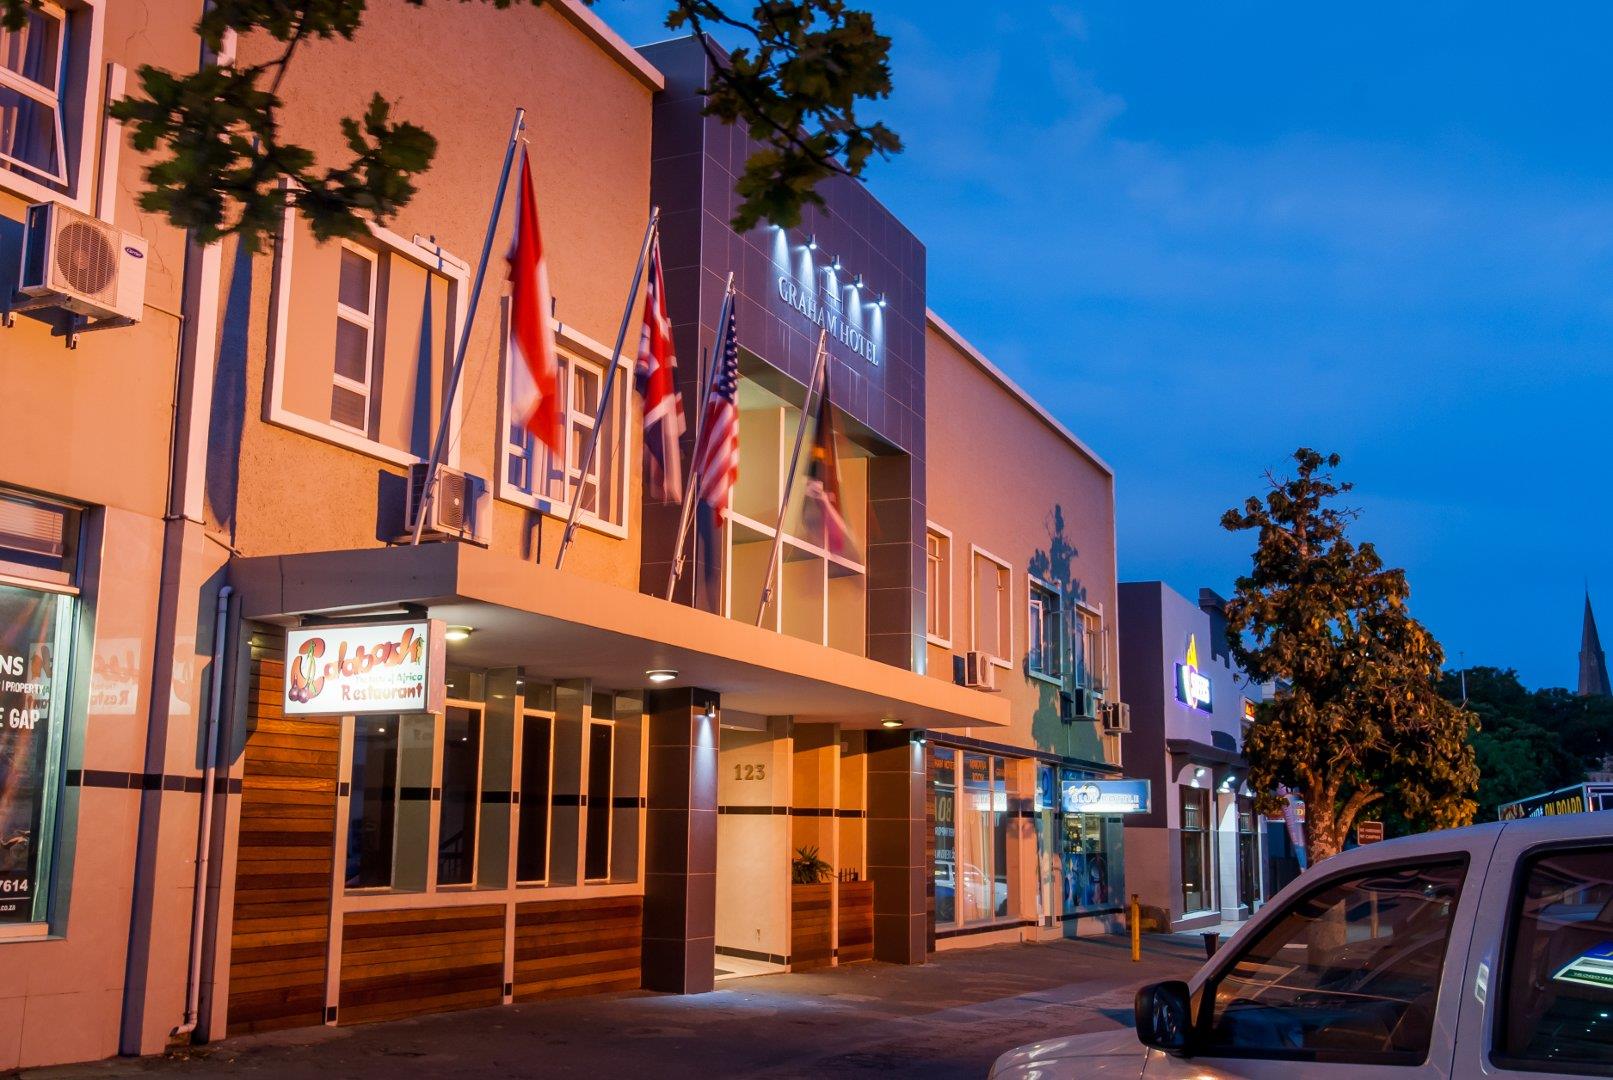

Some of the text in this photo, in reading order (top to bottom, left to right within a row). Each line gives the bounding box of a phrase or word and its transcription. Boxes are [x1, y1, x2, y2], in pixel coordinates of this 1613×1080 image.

[778, 276, 878, 366] GRAHAM HOTEL
[289, 627, 423, 701] Calabash
[397, 672, 422, 684] Africa
[5, 681, 44, 695] PROPERTY
[341, 683, 423, 700] Restaurant
[9, 708, 41, 730] GAP
[734, 764, 766, 781] 123
